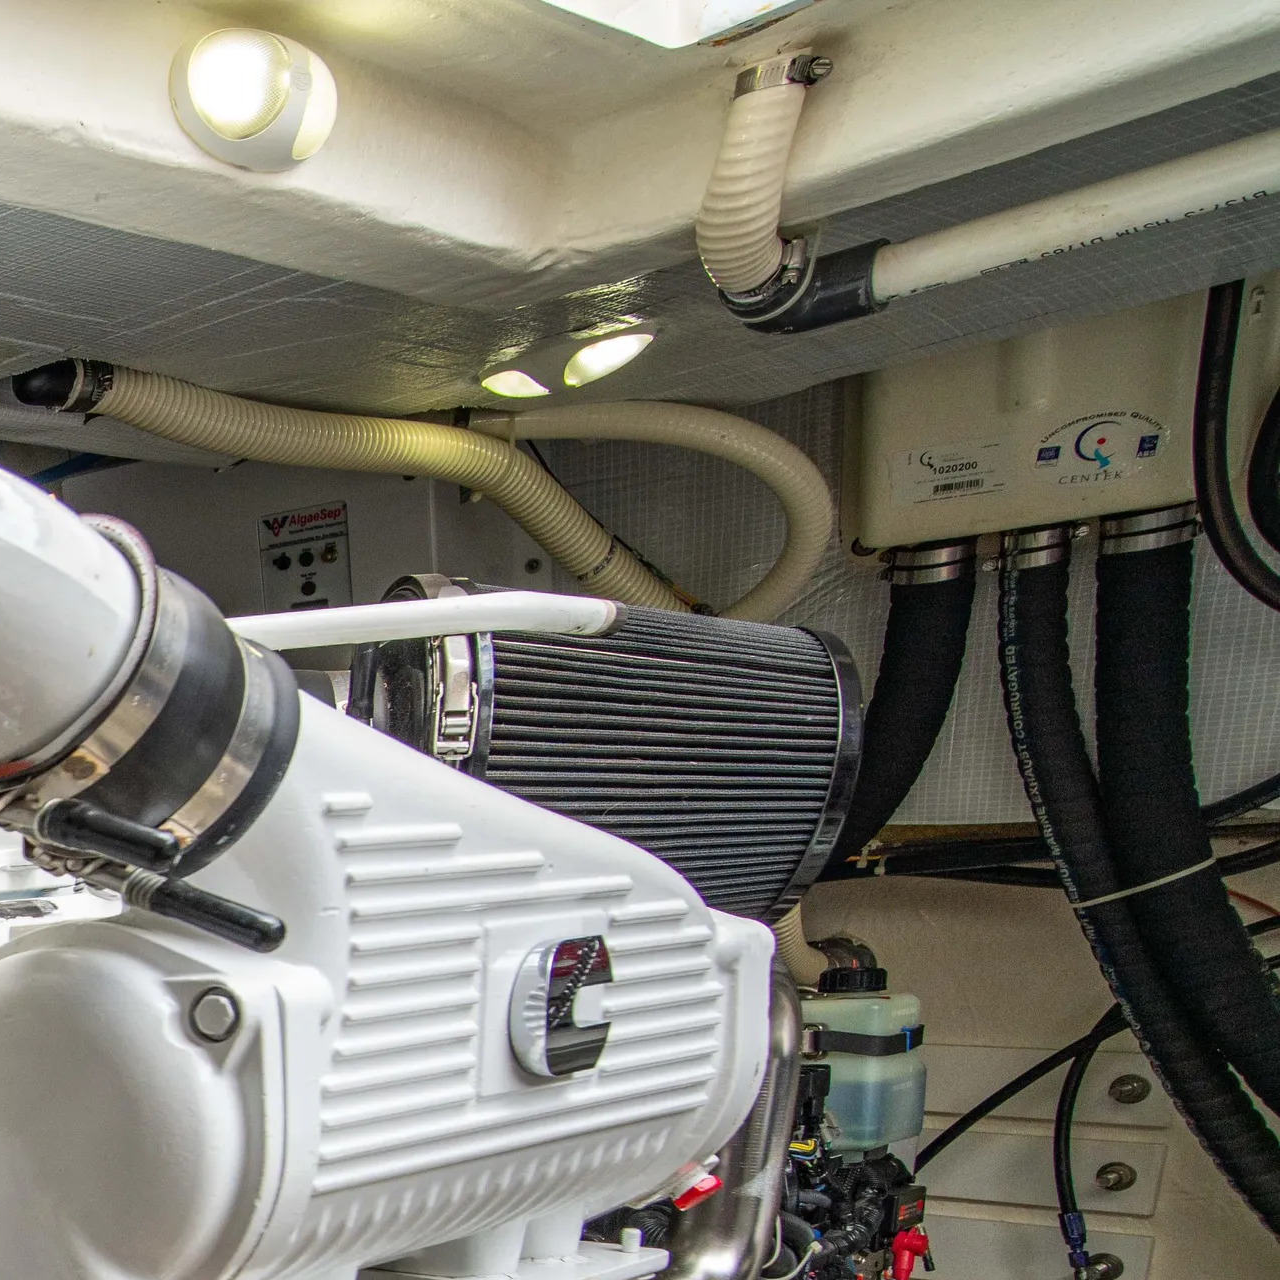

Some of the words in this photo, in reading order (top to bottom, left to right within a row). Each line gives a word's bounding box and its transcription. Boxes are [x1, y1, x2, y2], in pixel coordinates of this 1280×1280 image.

[1130, 411, 1163, 431] QUALITY
[933, 461, 978, 475] 1020200
[1058, 471, 1123, 484] CENTEK
[289, 508, 341, 526] AlgaeSep
